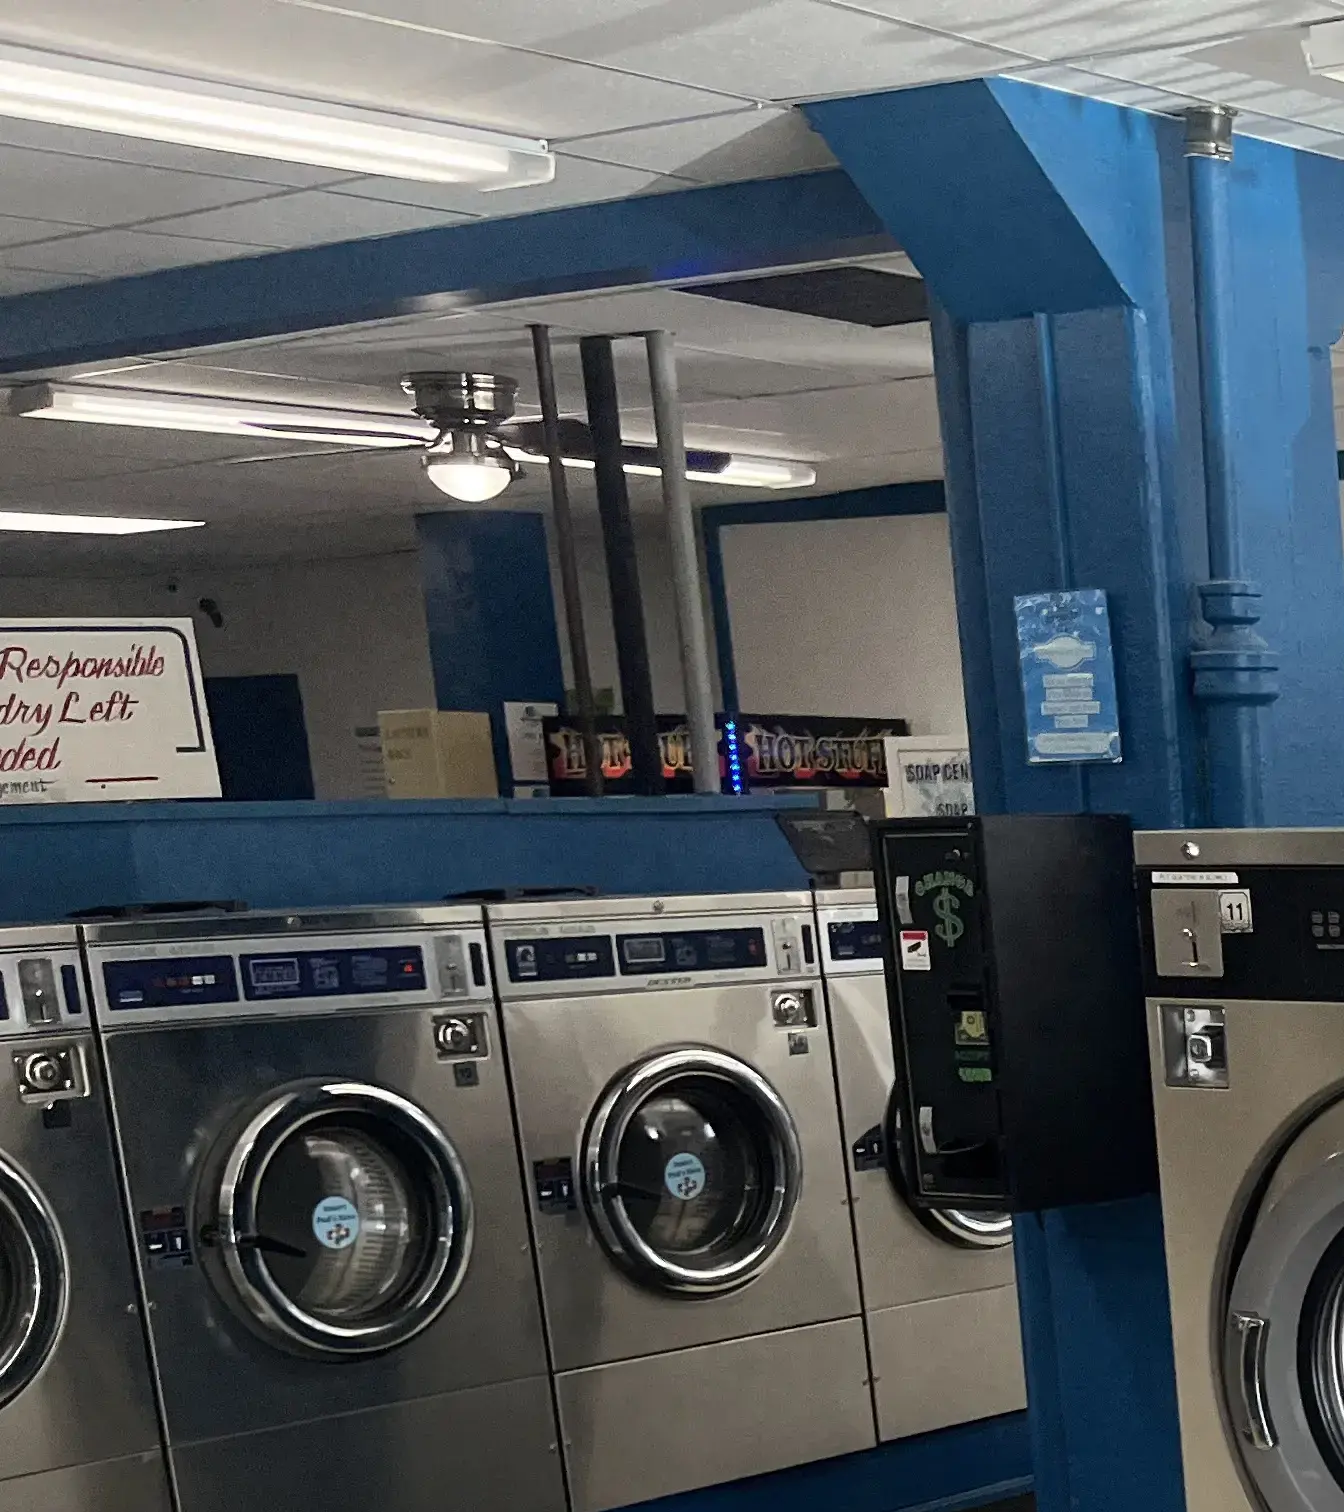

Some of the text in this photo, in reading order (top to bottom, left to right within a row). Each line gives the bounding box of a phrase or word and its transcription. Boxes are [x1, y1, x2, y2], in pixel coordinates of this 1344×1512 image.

[0, 644, 165, 689] Responsible
[58, 691, 139, 723] Left
[0, 737, 62, 772] ded
[756, 733, 815, 772] HOT
[0, 778, 60, 798] ement
[905, 764, 940, 782] SOAP
[1227, 903, 1243, 921] 11
